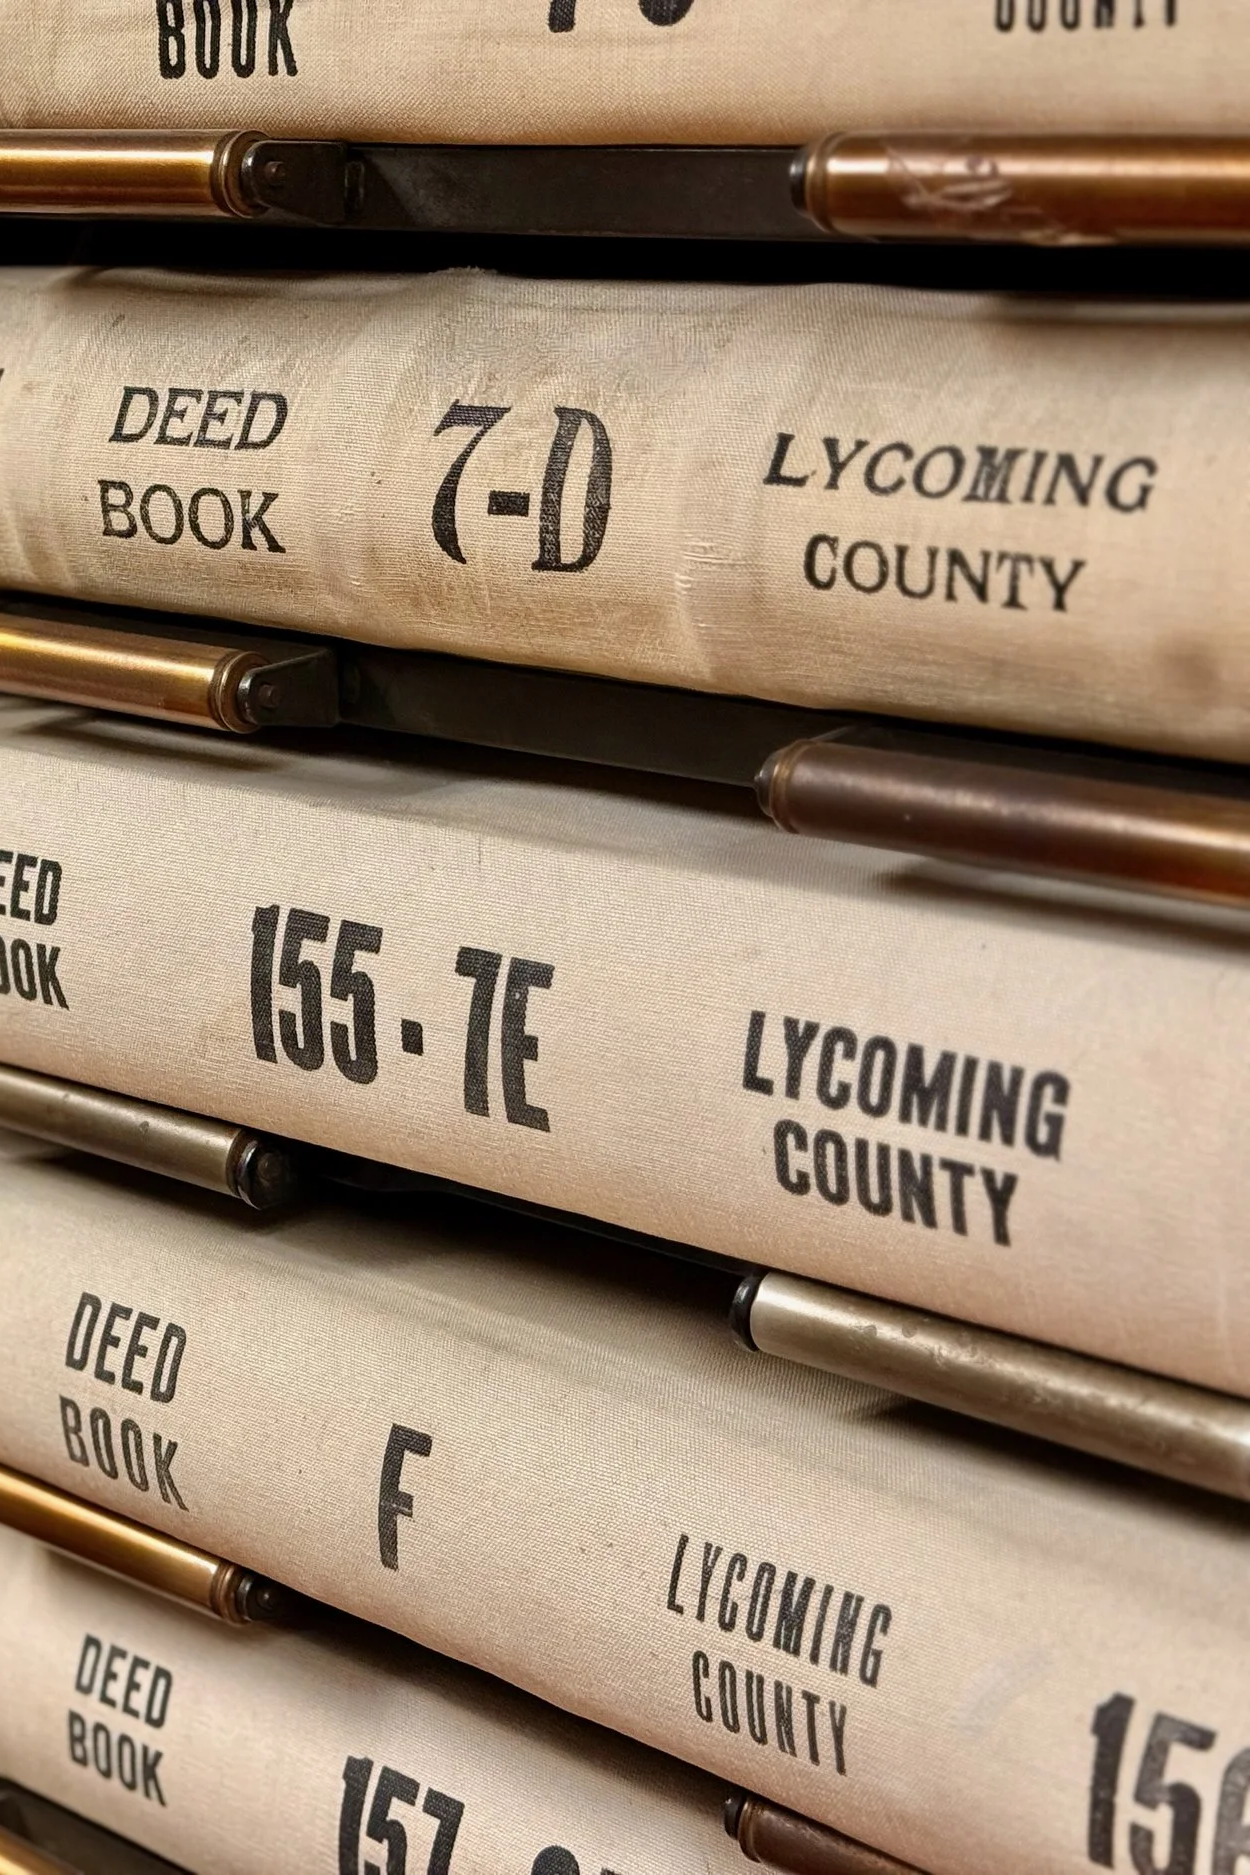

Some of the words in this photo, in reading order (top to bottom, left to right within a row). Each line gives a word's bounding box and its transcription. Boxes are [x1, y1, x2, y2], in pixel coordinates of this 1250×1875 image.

[156, 0, 298, 79] BOOK
[108, 385, 289, 451] DEED
[762, 432, 1158, 514] LYCOMING
[97, 478, 287, 555] BOOK
[431, 399, 613, 574] 7-D
[803, 533, 1085, 613] COUNTY
[742, 1010, 1072, 1162] LYCOMING
[773, 1118, 1019, 1248] COUNTY
[64, 1291, 188, 1404] DEED
[58, 1394, 190, 1512] BOOK
[377, 1423, 433, 1572] F
[666, 1533, 893, 1689] LYCOMING
[74, 1632, 173, 1730] DEED
[692, 1649, 849, 1777] COUNTY
[66, 1709, 168, 1807] BOOK
[337, 1756, 465, 1875] 157
